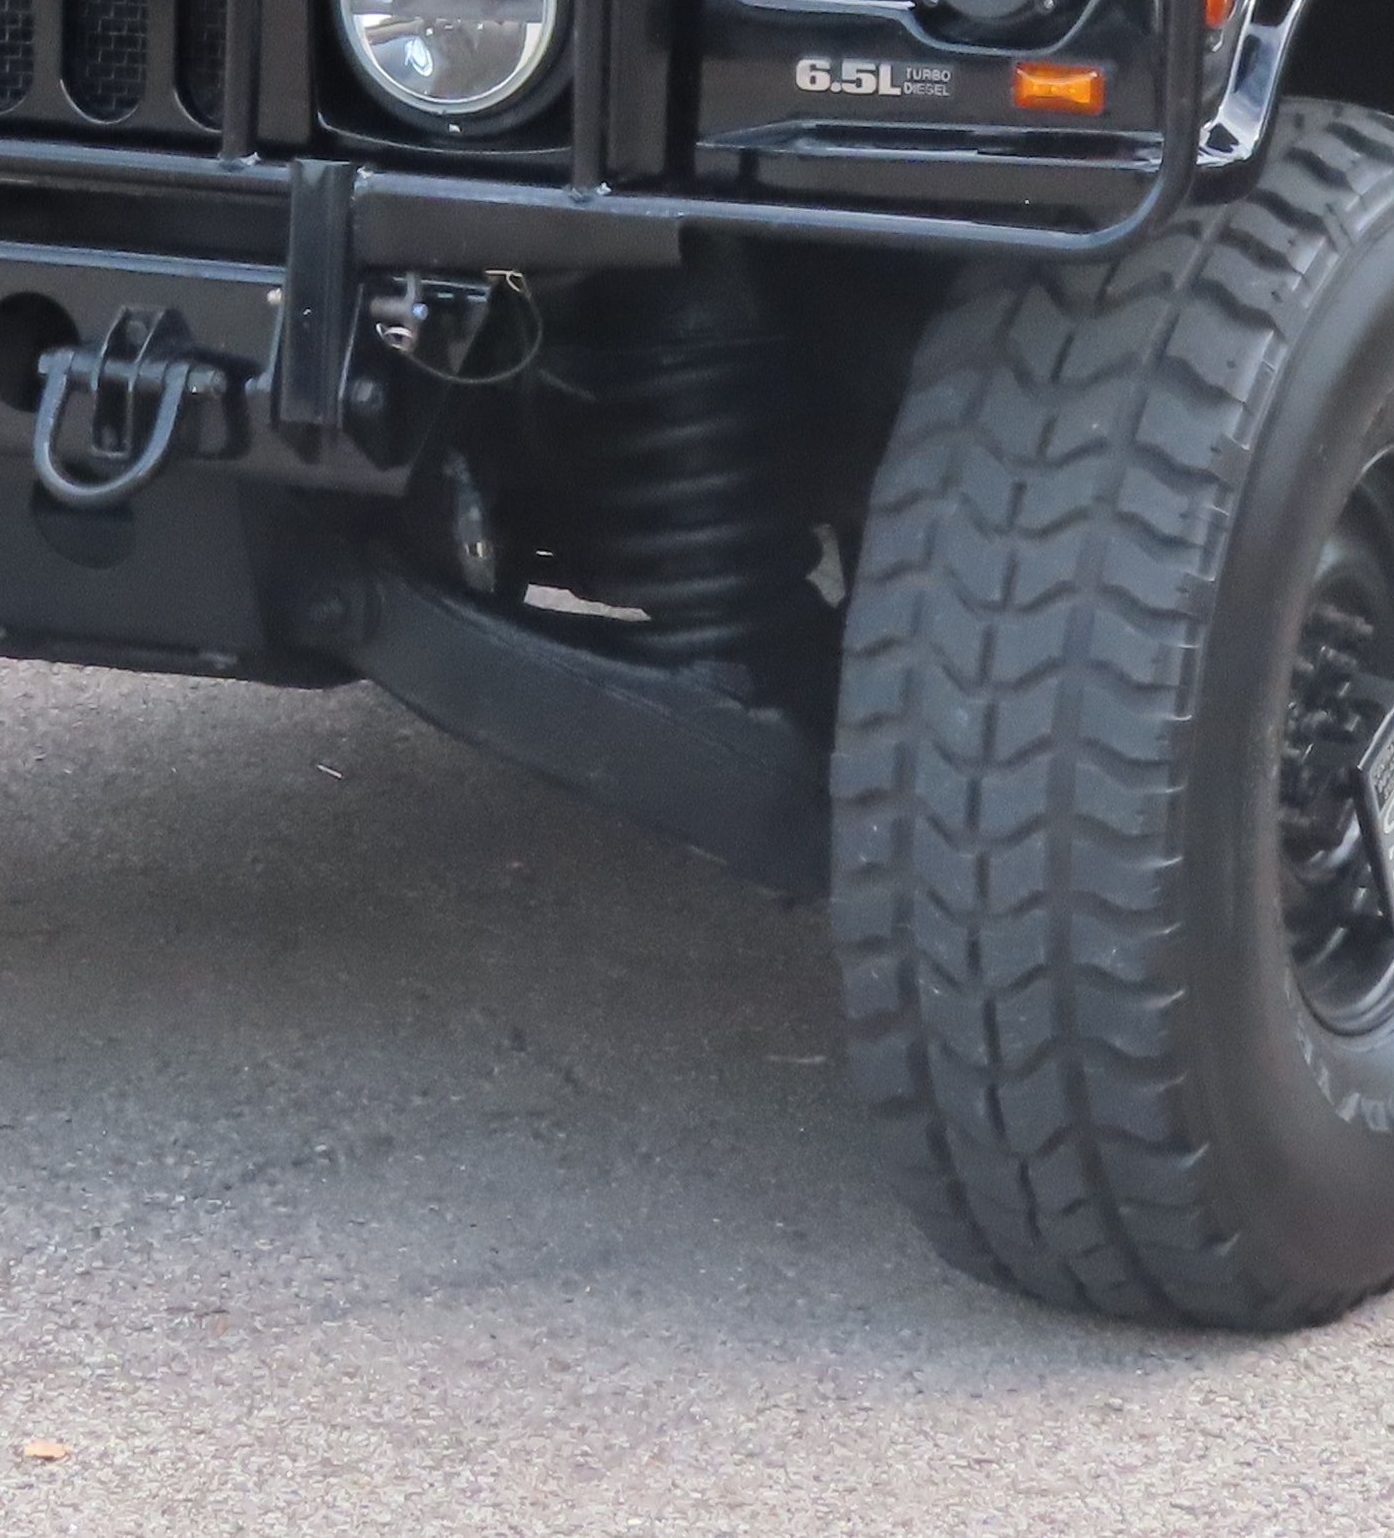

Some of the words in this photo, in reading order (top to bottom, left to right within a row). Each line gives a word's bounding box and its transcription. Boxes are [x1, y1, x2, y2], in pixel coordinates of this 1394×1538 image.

[795, 59, 902, 96] 6.5L
[906, 67, 951, 82] TURBO
[904, 81, 950, 97] DIESEL
